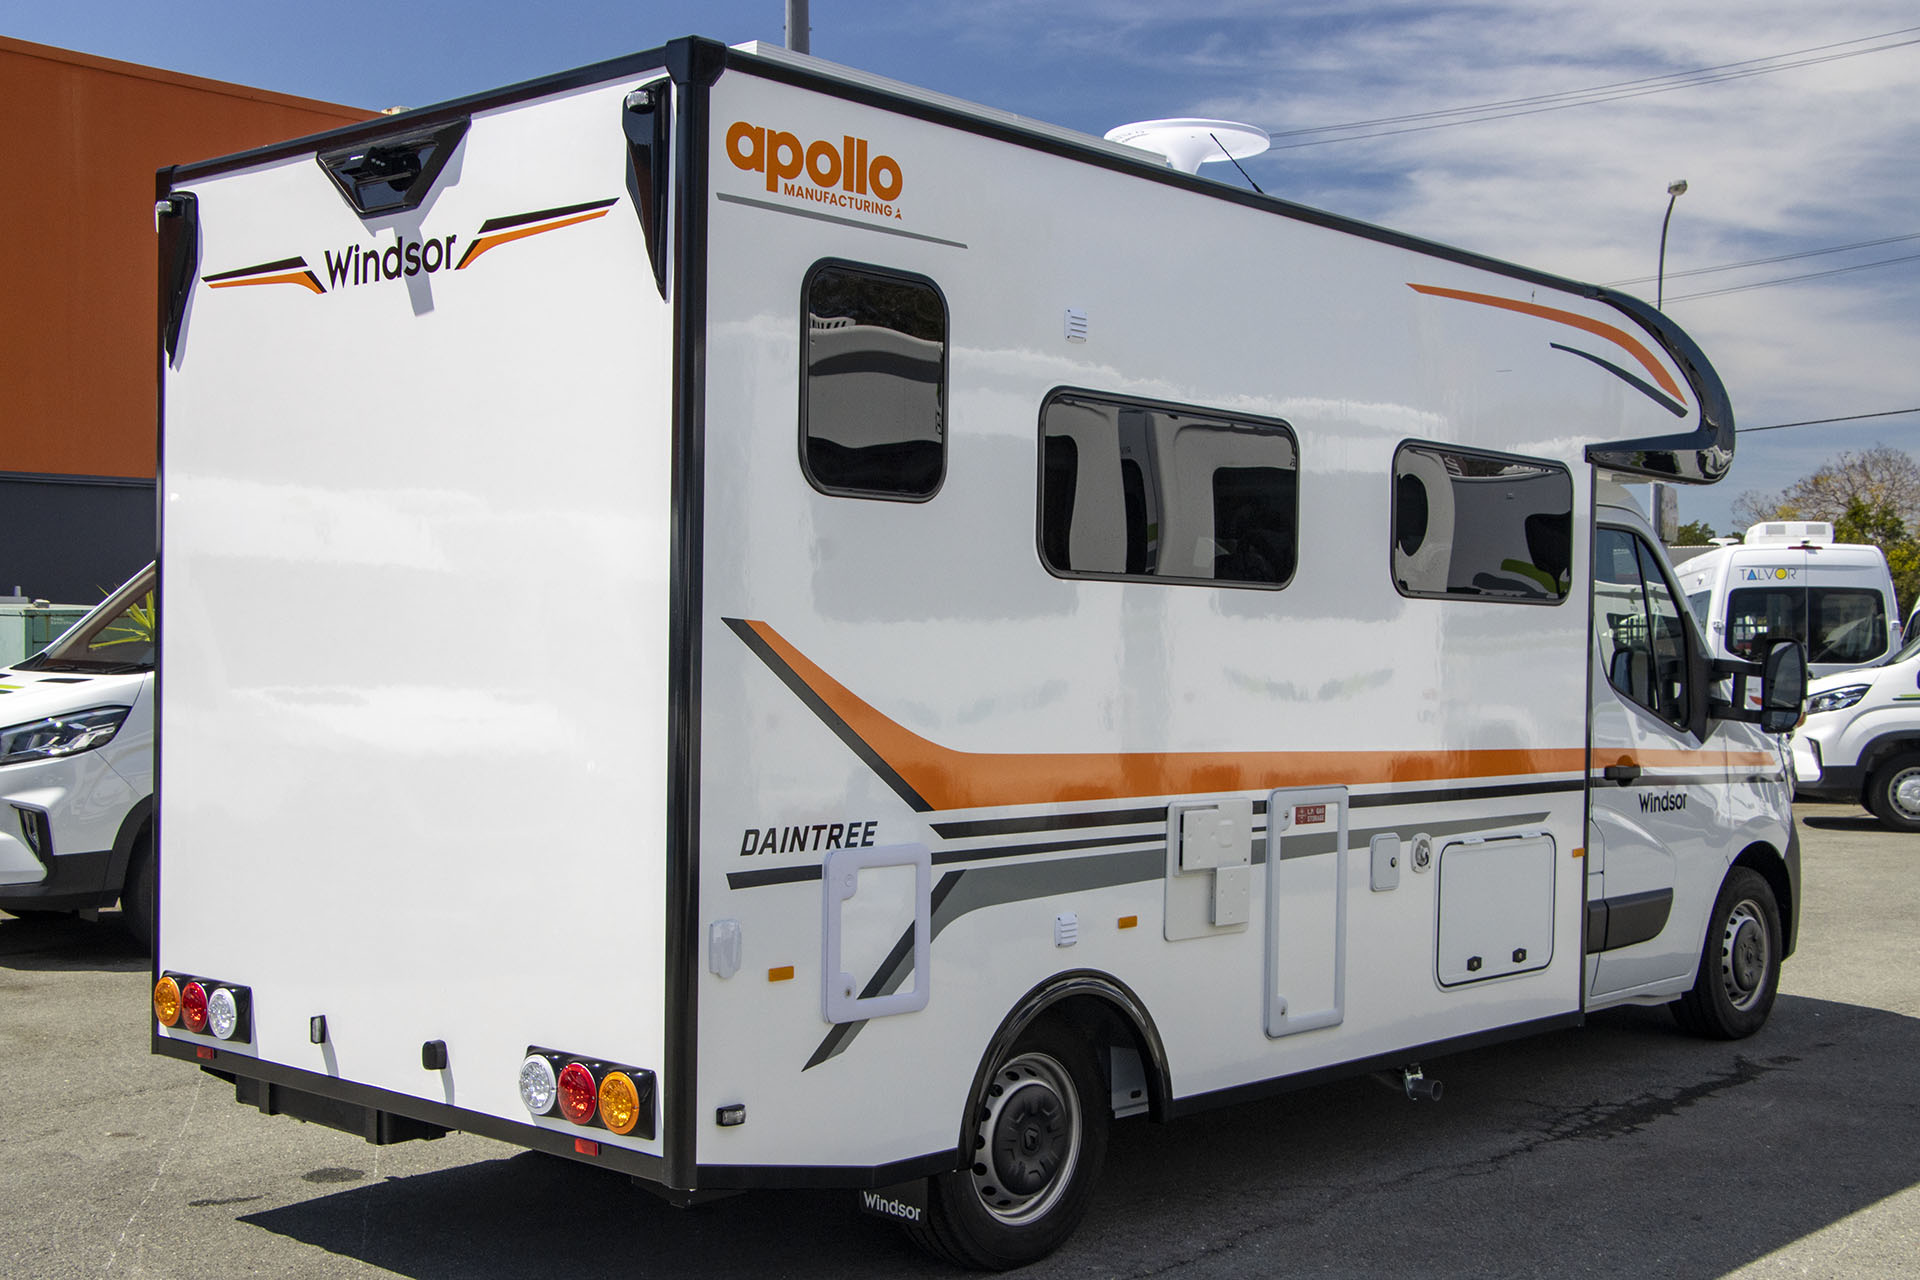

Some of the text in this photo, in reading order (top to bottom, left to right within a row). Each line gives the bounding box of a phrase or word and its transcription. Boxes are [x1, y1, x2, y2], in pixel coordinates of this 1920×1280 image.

[726, 121, 903, 201] apollo
[784, 183, 893, 217] MANUFACTURING
[324, 234, 457, 290] Windsor
[1740, 568, 1797, 580] TALVOR
[1638, 791, 1687, 813] Windsor
[740, 821, 878, 856] DAINTREE
[863, 1191, 921, 1221] Windsor
